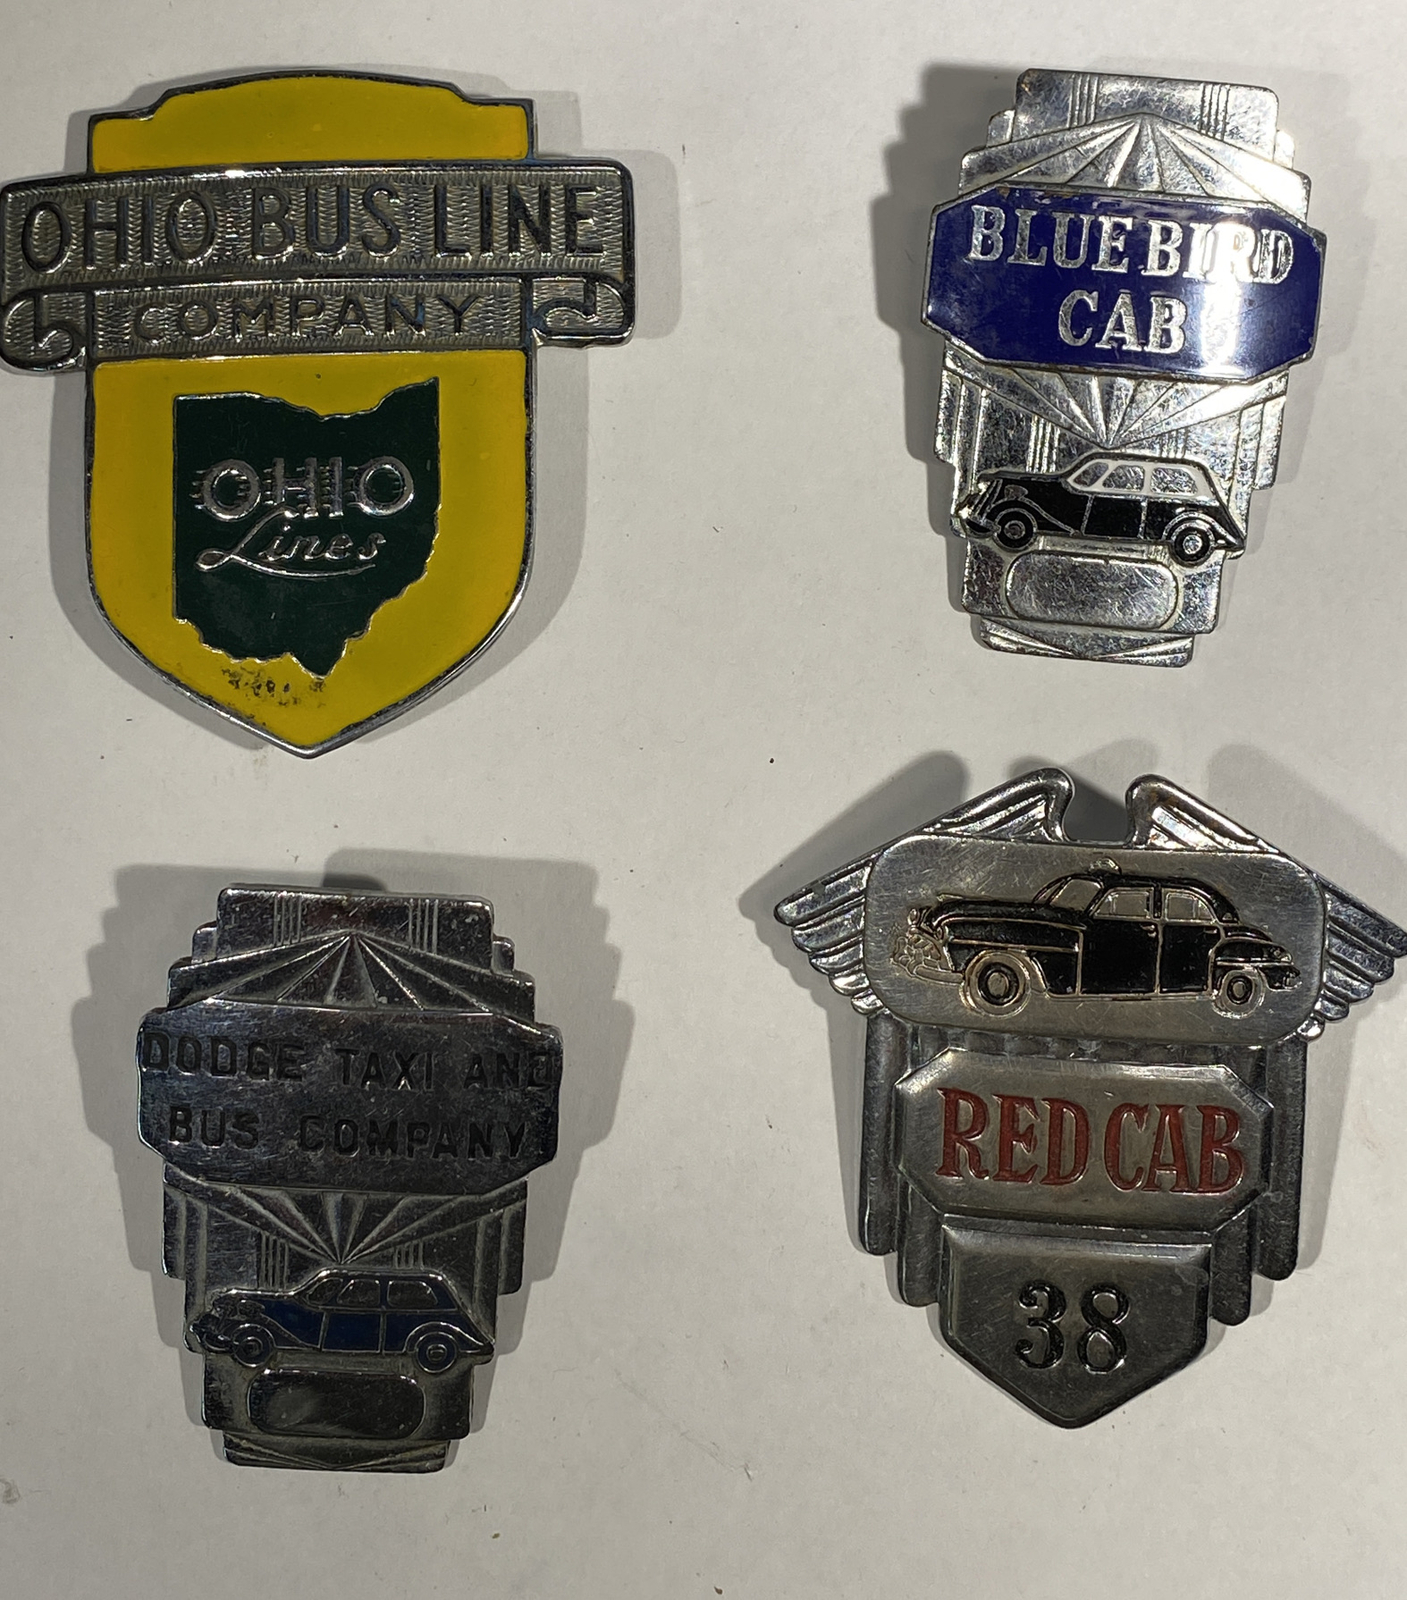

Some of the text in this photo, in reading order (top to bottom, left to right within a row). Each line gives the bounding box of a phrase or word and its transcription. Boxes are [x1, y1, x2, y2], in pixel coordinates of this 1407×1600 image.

[21, 184, 604, 275] OHIO BUS LINE
[967, 205, 1295, 286] BLUE BIRD
[134, 296, 479, 344] COMPANY
[1057, 289, 1189, 355] CAB
[200, 456, 415, 522] OHIO
[195, 504, 387, 579] Lines
[141, 1030, 306, 1082] DODGE
[335, 1047, 437, 1093] TAXI
[168, 1104, 529, 1160] BUS COMPANY
[935, 1087, 1246, 1196] RED CAB
[1014, 1279, 1131, 1375] 38
